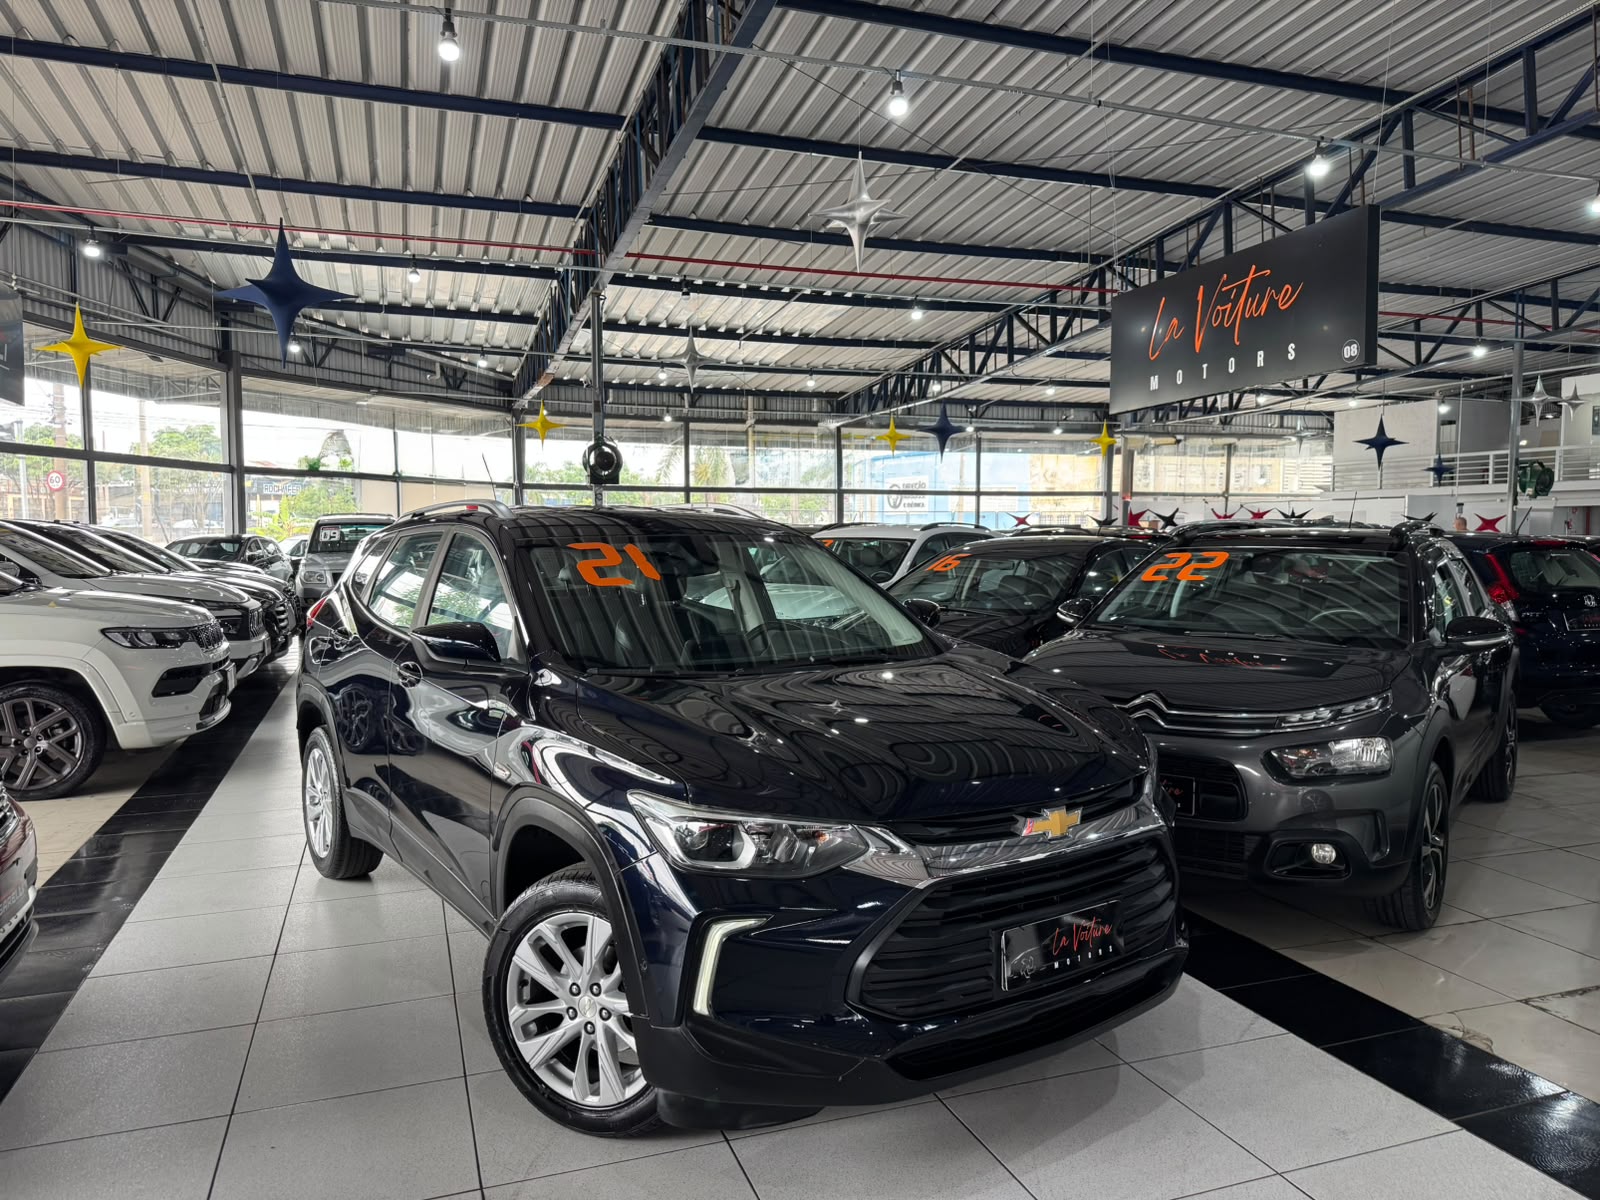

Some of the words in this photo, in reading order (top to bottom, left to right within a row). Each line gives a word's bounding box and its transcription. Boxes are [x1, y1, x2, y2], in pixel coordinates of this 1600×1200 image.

[1149, 296, 1185, 361] La
[1194, 264, 1304, 354] Voiture
[1149, 342, 1297, 392] MOTORS
[1343, 342, 1358, 359] 08
[50, 475, 61, 484] 60
[566, 541, 662, 587] 21
[925, 553, 973, 573] 16
[1141, 551, 1230, 582] 22
[1052, 927, 1070, 956] La
[1073, 915, 1113, 952] Voiture
